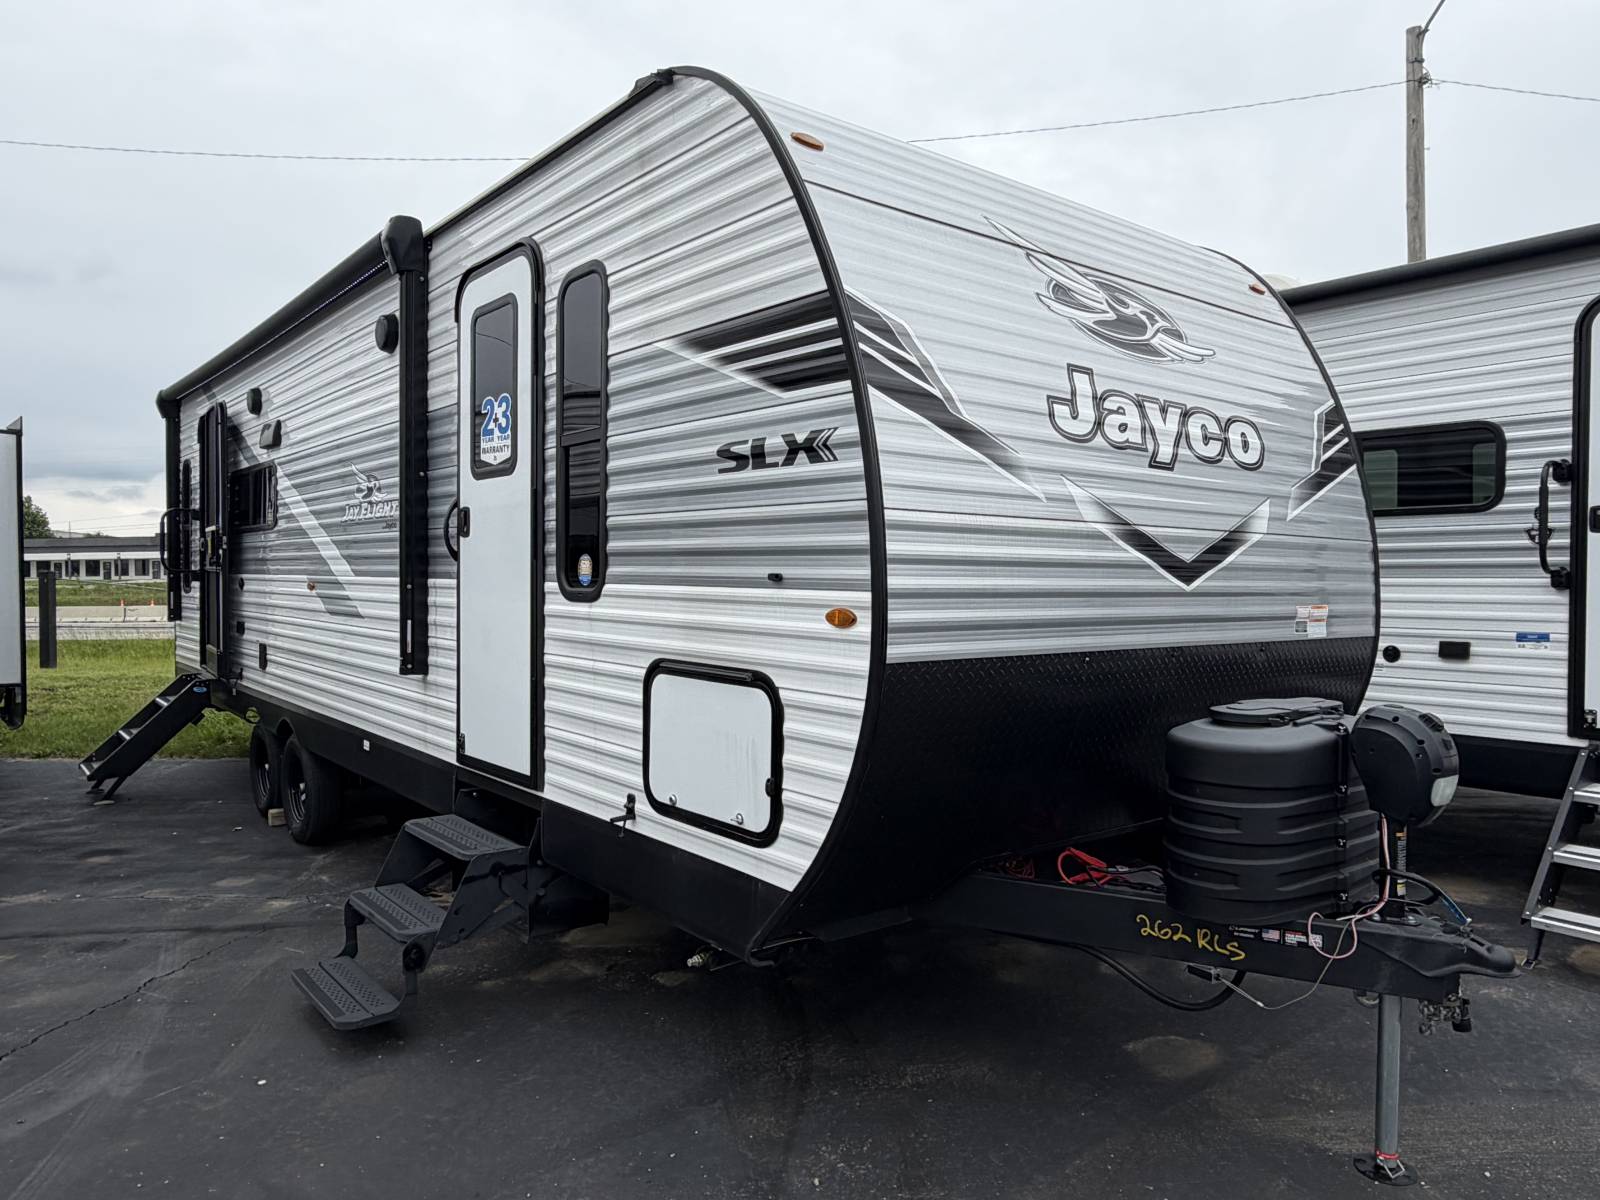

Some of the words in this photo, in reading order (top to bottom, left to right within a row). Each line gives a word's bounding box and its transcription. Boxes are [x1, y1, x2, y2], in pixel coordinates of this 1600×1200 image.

[1046, 362, 1265, 472] Jayco
[481, 444, 510, 455] WARRANTY
[716, 426, 840, 475] SLX
[1136, 914, 1192, 944] 262
[1197, 928, 1246, 962] RLS
